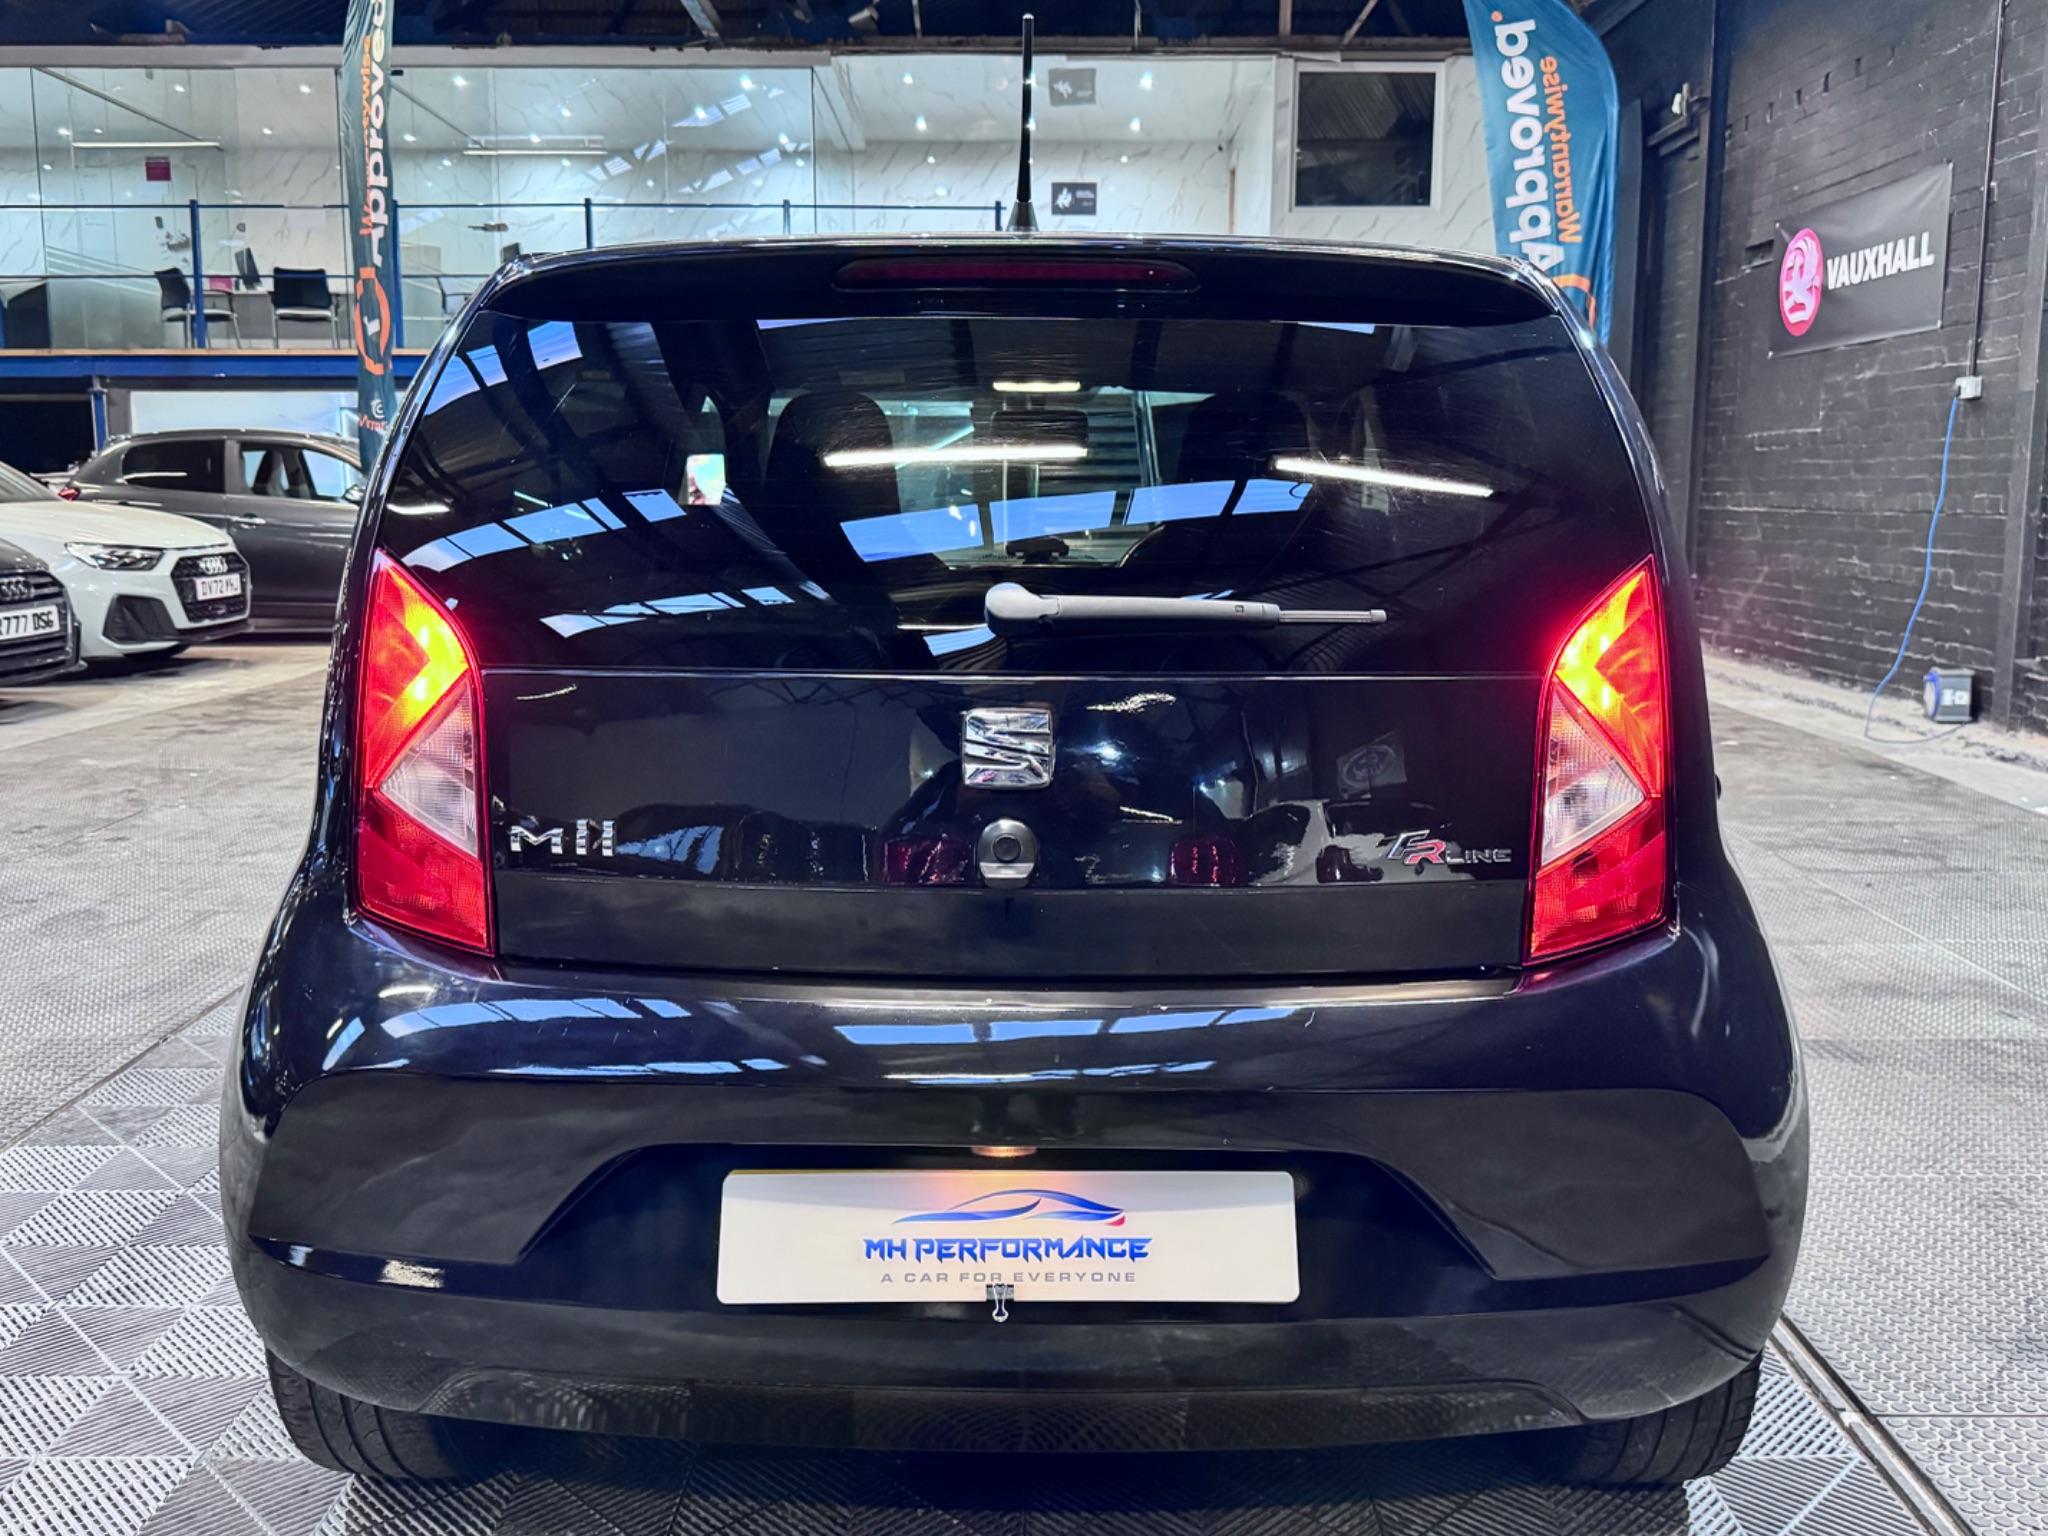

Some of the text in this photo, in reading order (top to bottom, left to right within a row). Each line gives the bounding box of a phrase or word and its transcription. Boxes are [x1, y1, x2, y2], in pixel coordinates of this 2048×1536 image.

[1827, 231, 1935, 290] VAUXHALL
[32, 610, 54, 631] DSG
[1446, 848, 1512, 864] LINE
[863, 1235, 1154, 1264] MH PERFORMANCE
[880, 1272, 1137, 1283] A CAR FOR EVERYONE
